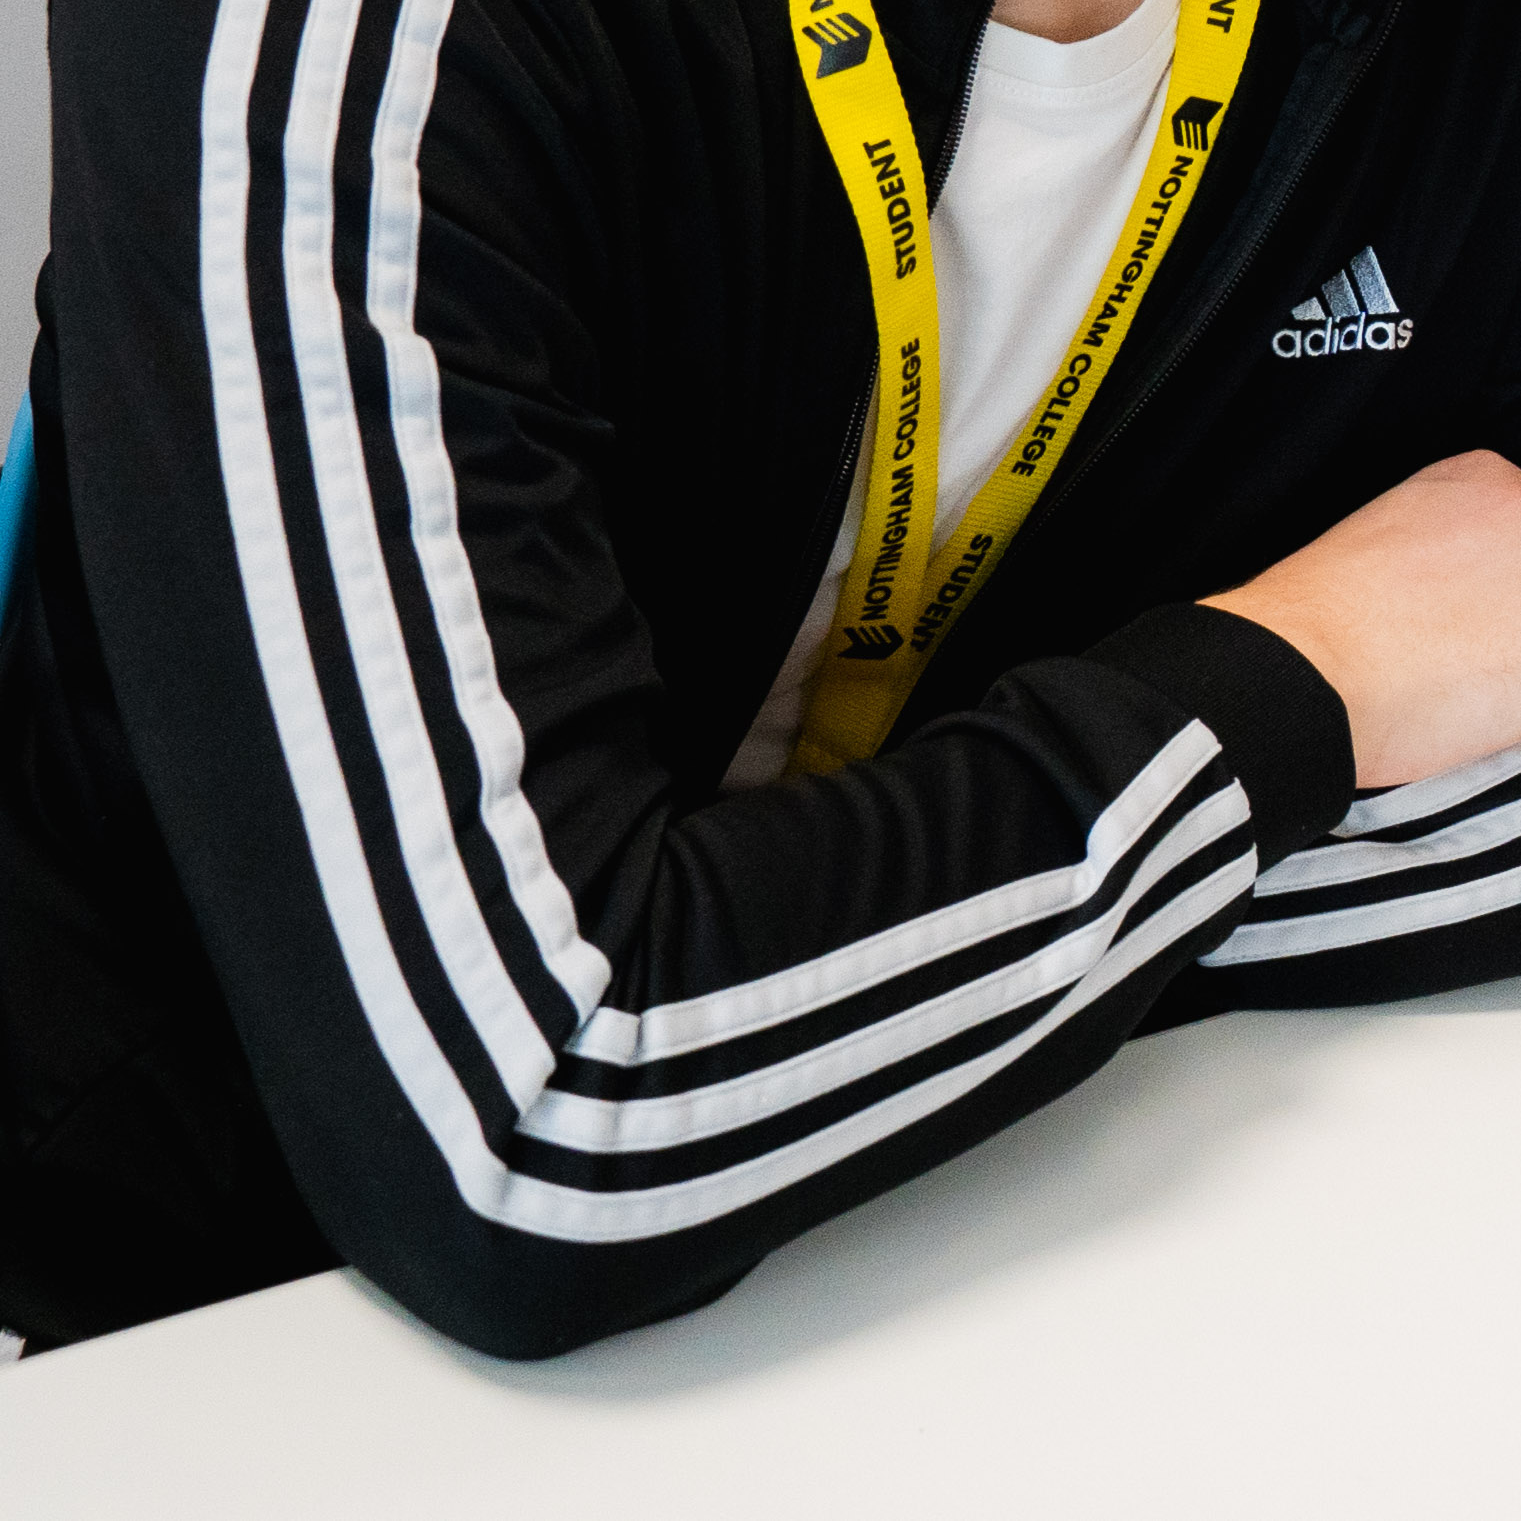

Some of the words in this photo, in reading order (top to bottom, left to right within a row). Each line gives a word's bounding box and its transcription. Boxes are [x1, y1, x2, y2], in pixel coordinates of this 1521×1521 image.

[862, 138, 917, 280] STUDENT
[1081, 154, 1194, 348] NOTTINGHAM
[1271, 311, 1414, 359] adidas
[859, 463, 914, 622] NOTTINGHAM
[893, 336, 922, 462] COLLEGE
[1011, 352, 1082, 478] COLLEGE
[910, 533, 993, 653] STUDENT
